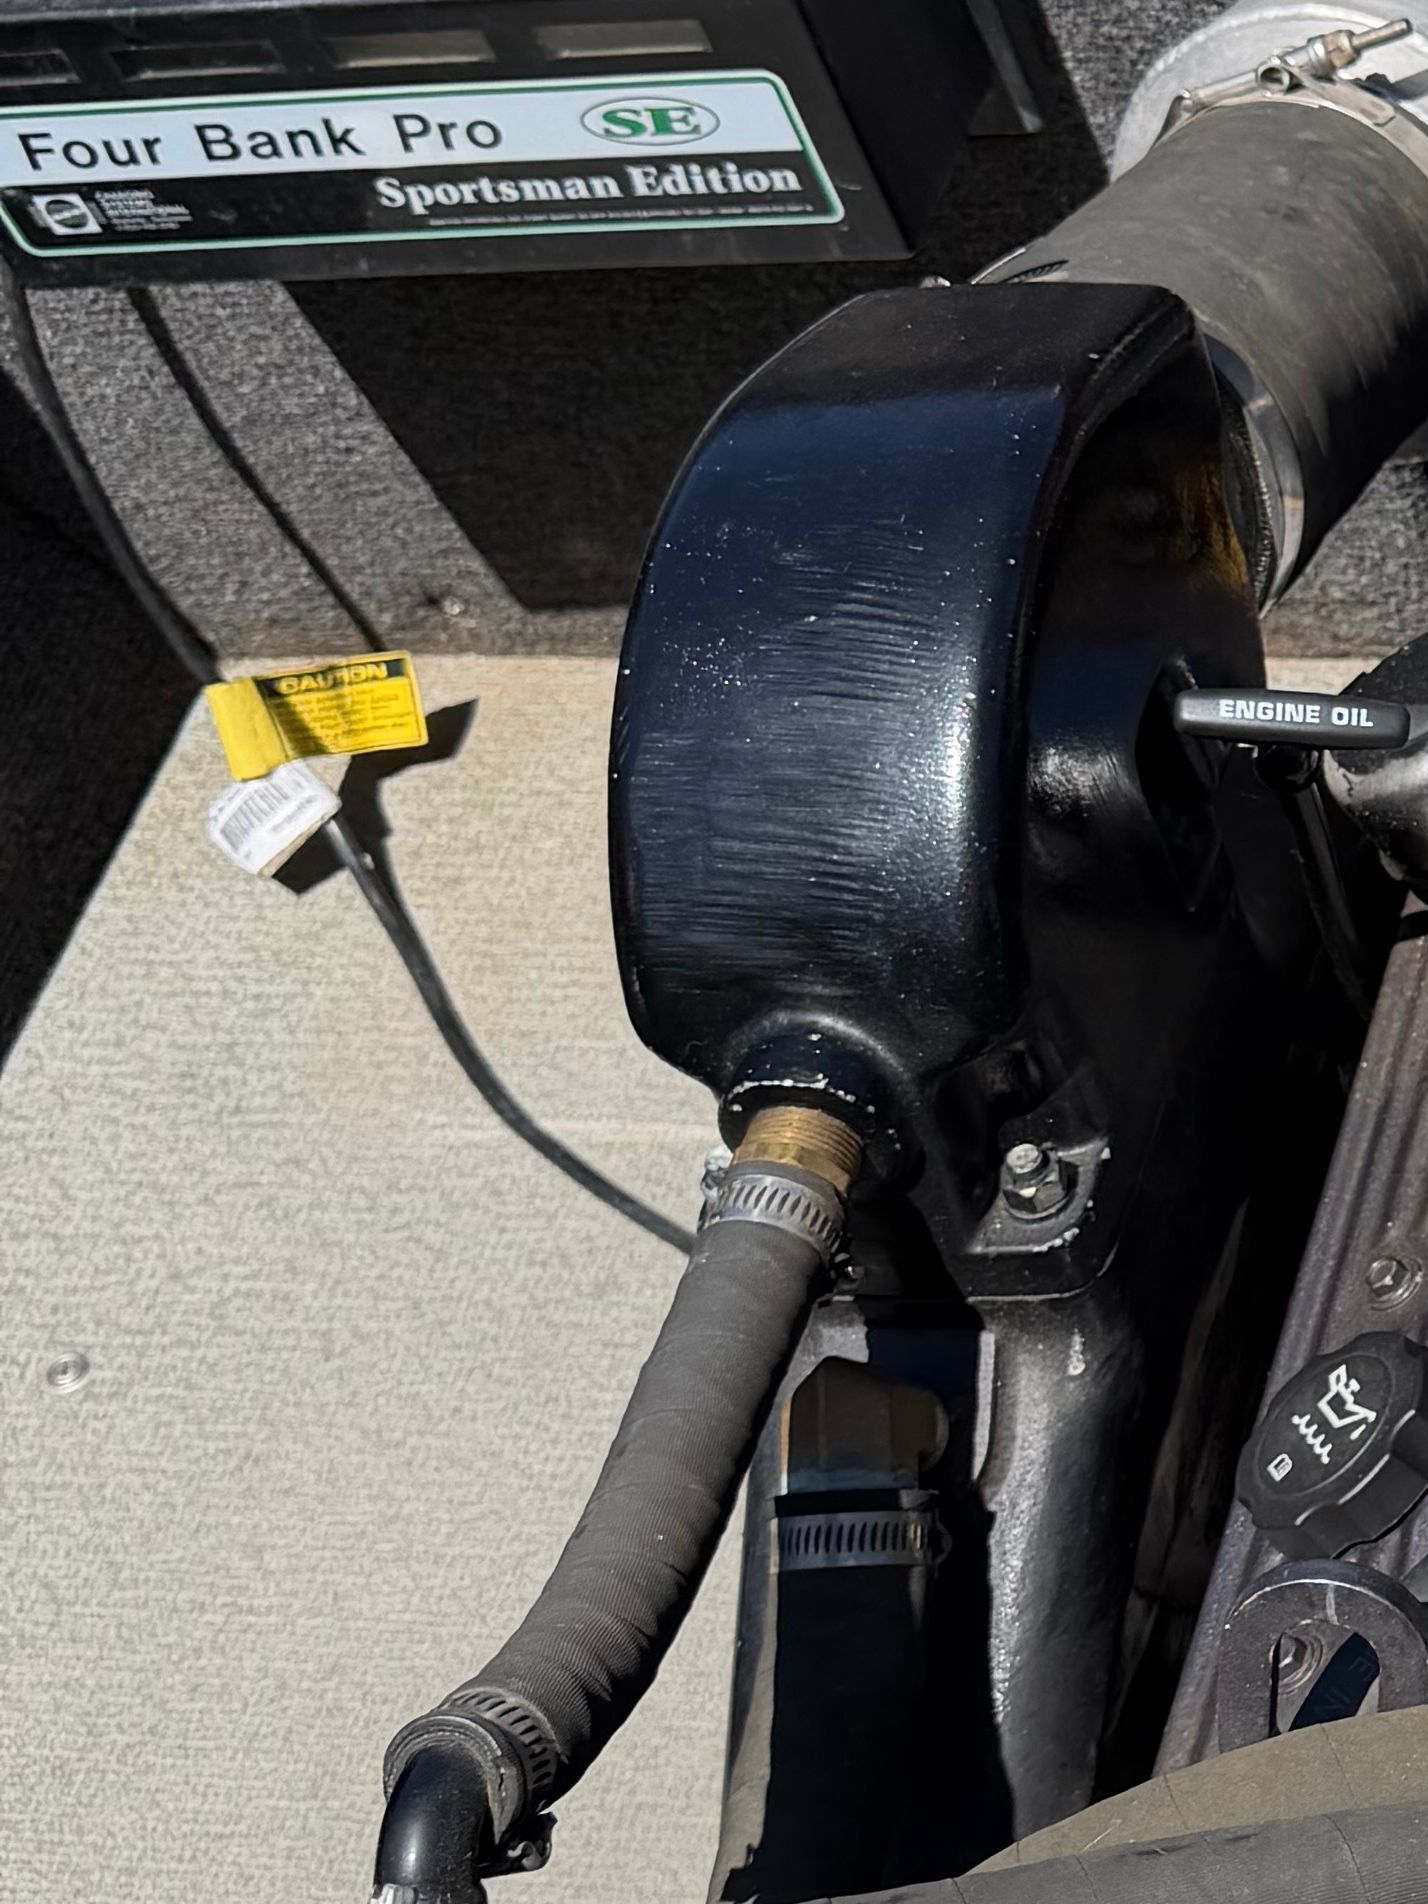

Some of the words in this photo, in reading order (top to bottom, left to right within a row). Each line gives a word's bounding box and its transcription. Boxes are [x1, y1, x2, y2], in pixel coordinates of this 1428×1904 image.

[17, 129, 164, 173] Four
[192, 116, 368, 166] Bank
[391, 110, 504, 154] Pro
[599, 107, 704, 140] SE
[374, 166, 620, 214] Sportsman
[624, 161, 803, 199] Edition
[1219, 699, 1320, 724] ENGINE
[1331, 706, 1374, 727] OIL
